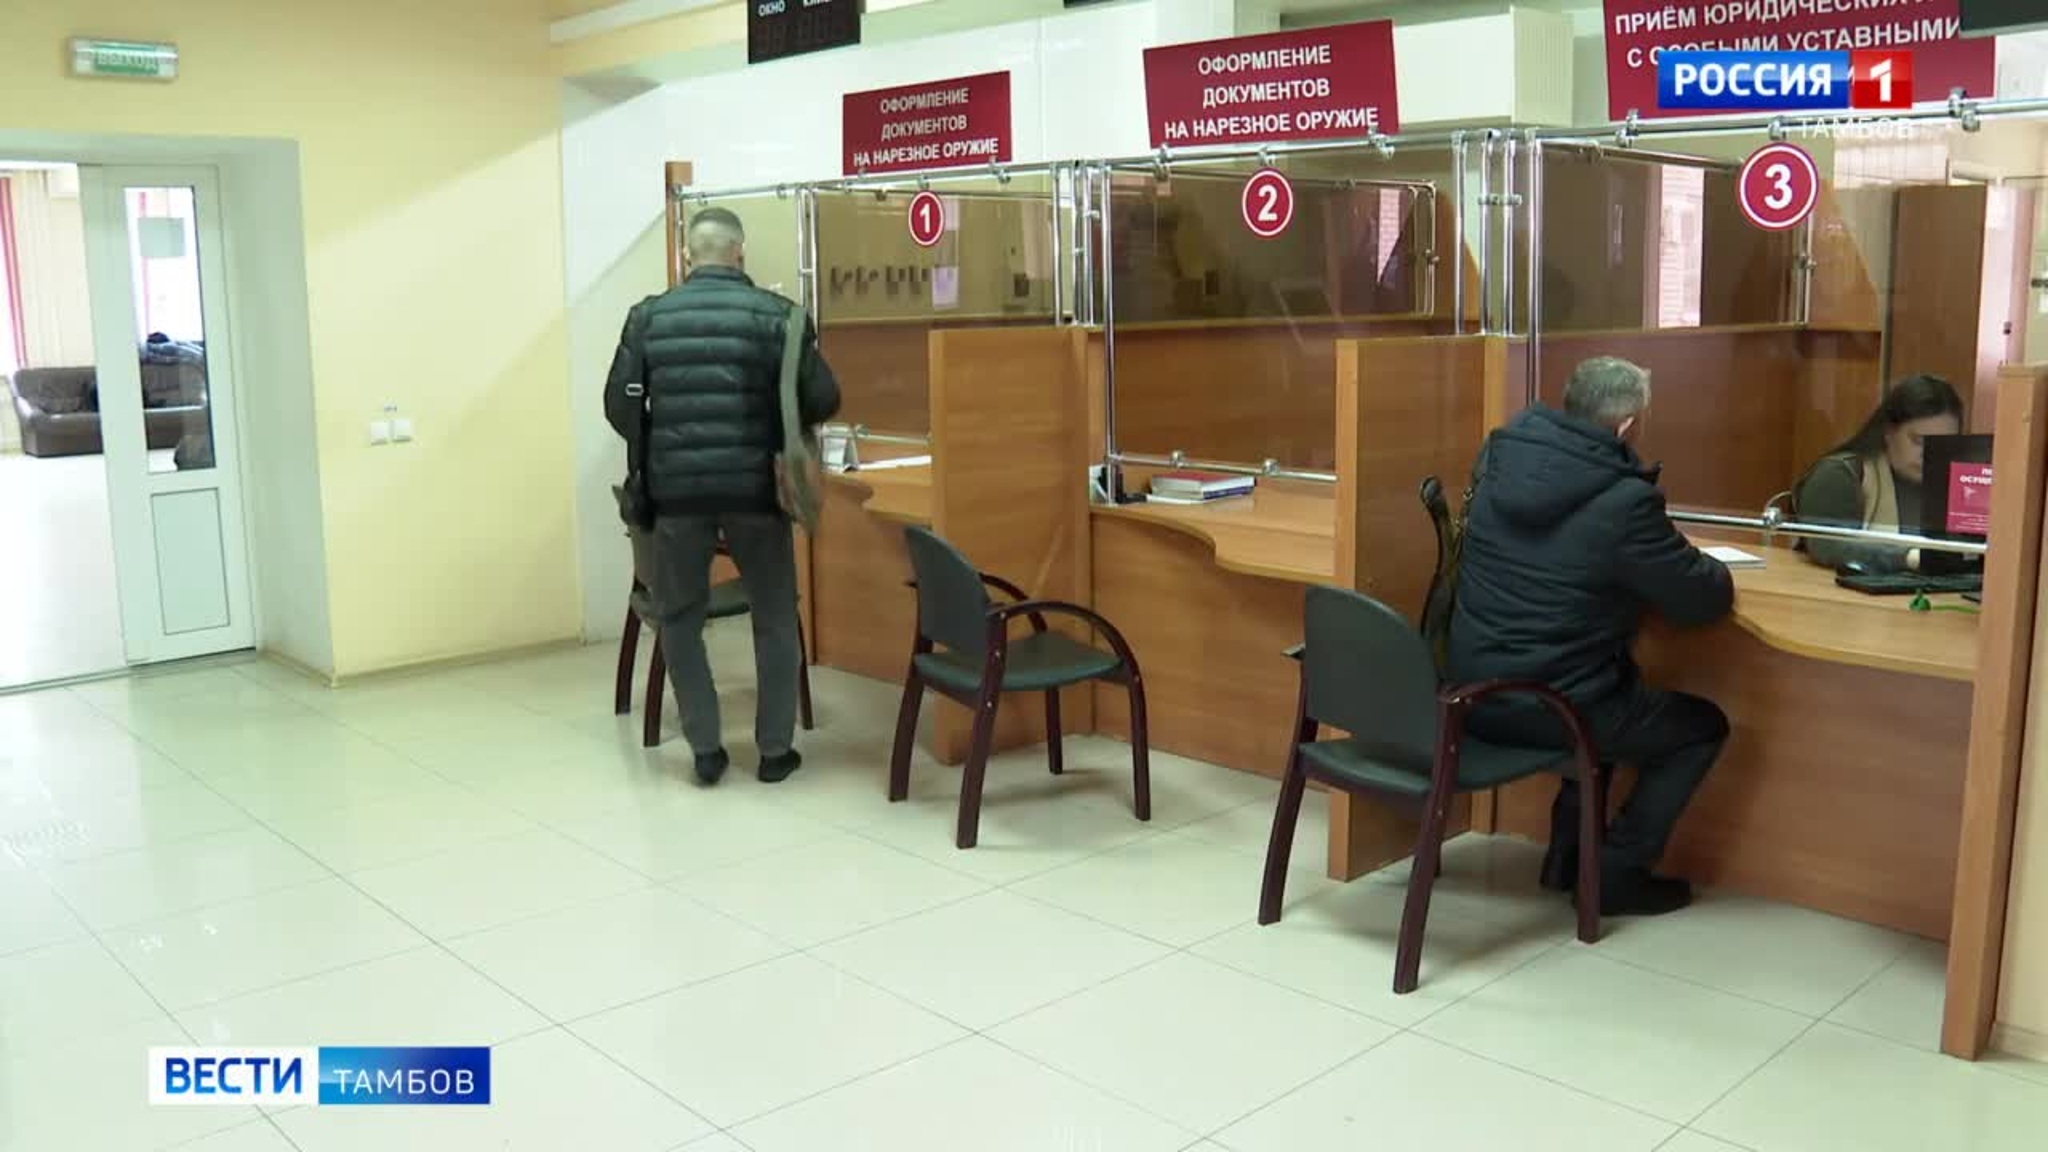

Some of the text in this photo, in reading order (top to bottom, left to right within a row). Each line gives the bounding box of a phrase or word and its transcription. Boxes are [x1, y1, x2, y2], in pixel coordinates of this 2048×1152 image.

[758, 1, 785, 16] ОКНО
[1615, 0, 1908, 34] ПРИЁМ ЮРИДИЧЕС
[1627, 48, 1642, 68] С
[1785, 16, 1960, 51] УСТАВНЫМИ
[1198, 44, 1331, 75] ОФОРМЛЕНИЕ
[880, 88, 969, 114] ОФОРМЛЕНИЕ
[1203, 78, 1331, 109] ДОКУМЕНТОВ
[881, 114, 968, 142] ДОКУМЕНТОВ
[1164, 107, 1379, 139] НА НАРЕЗНОЕ ОРУЖИЕ
[853, 137, 999, 167] НА НАРЕЗНОЕ ОРУЖИЕ
[1764, 163, 1793, 209] 3
[920, 203, 930, 233] 1
[1258, 184, 1278, 221] 2
